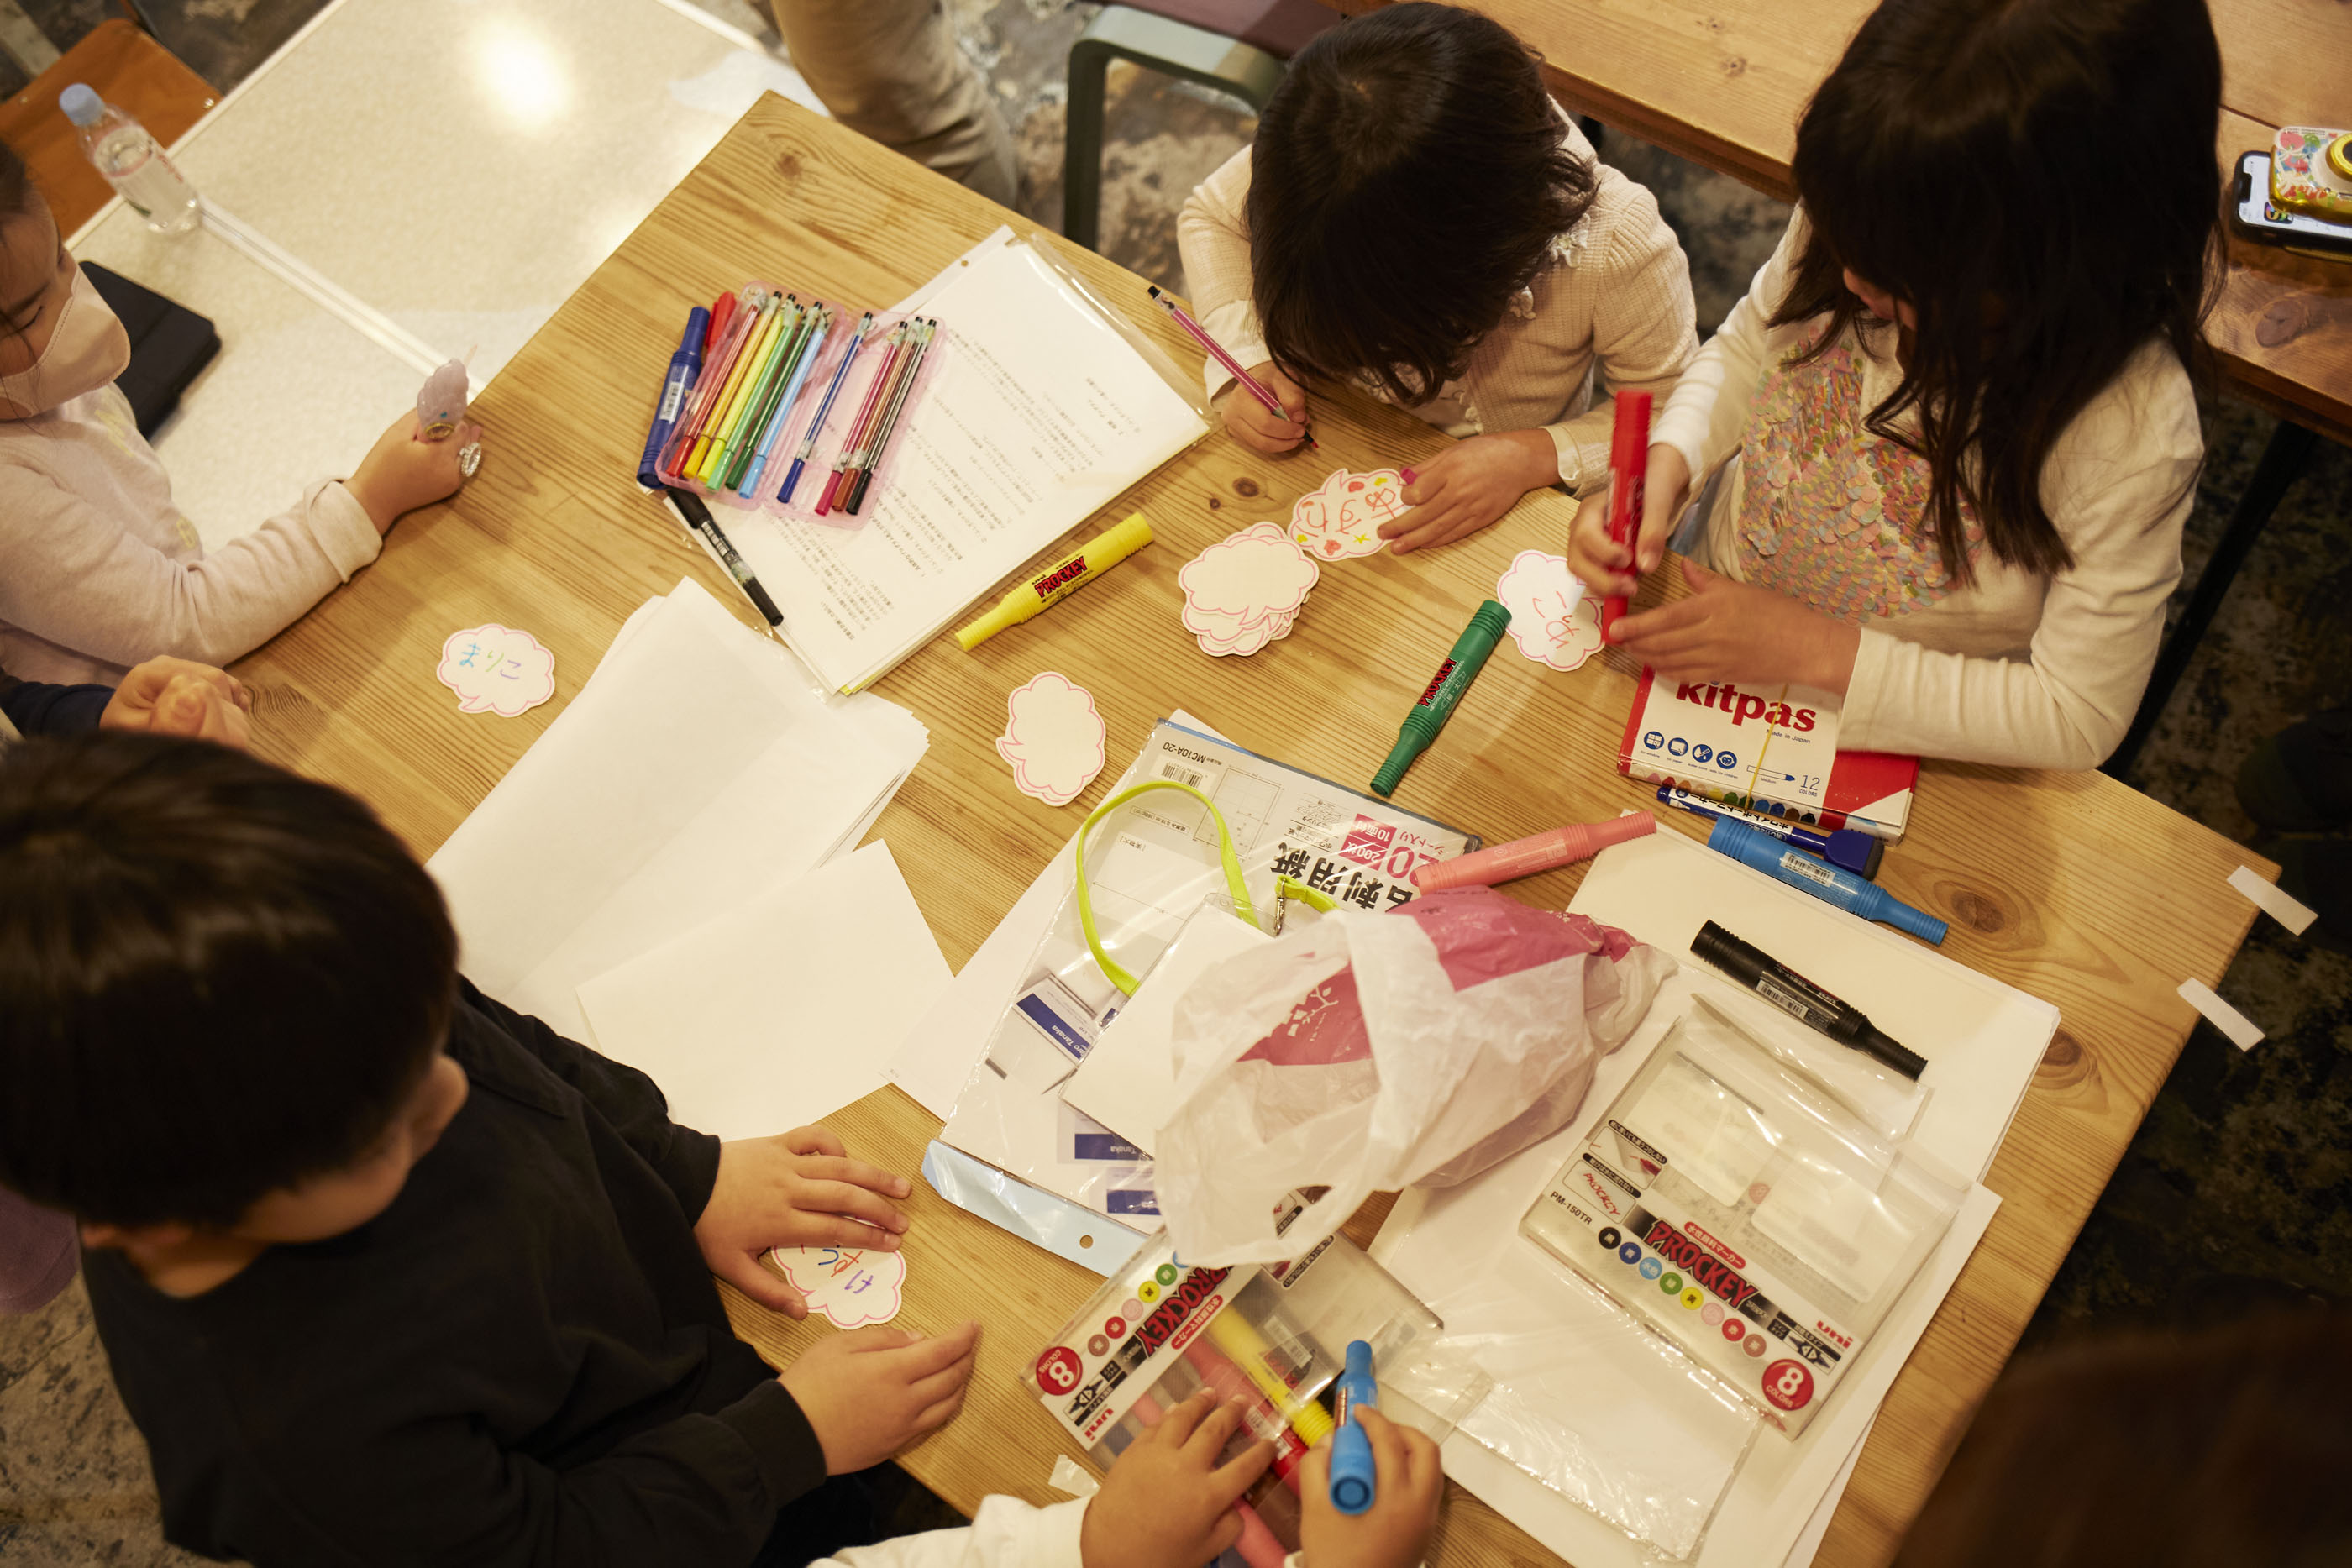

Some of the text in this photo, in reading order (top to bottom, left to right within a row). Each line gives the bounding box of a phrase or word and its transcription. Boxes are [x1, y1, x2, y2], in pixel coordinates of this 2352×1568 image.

[1034, 555, 1089, 599] PROCKEY
[459, 642, 522, 680] まりこ
[1417, 657, 1457, 708] PROCKEY
[1676, 680, 1817, 732] kitpas
[1162, 741, 1206, 763] MC10A-20
[1791, 735, 1811, 744] Japan
[1798, 788, 1818, 797] COLORS
[1800, 774, 1820, 791] 12
[1398, 828, 1445, 855] シート入り
[1049, 1023, 1074, 1046] Tanaka
[1110, 1145, 1136, 1155] Tanaka
[1548, 1189, 1593, 1227] PM-150TR
[1622, 1246, 1637, 1261] 青
[1684, 1222, 1745, 1270] 水性顔料マーカー
[801, 1243, 874, 1294] うすけ
[1640, 1259, 1661, 1277] 水色
[1641, 1218, 1761, 1314] PROCKEY
[1683, 1291, 1699, 1307] 黄
[1171, 1296, 1221, 1348] 水性顔料マーカー
[1726, 1322, 1740, 1337] 赤
[1813, 1318, 1854, 1350] uni
[1037, 1348, 1063, 1374] COLORS
[1043, 1356, 1078, 1392] 8
[1773, 1362, 1807, 1398] 8
[1763, 1383, 1795, 1408] COLORS
[1082, 1405, 1115, 1441] uni
